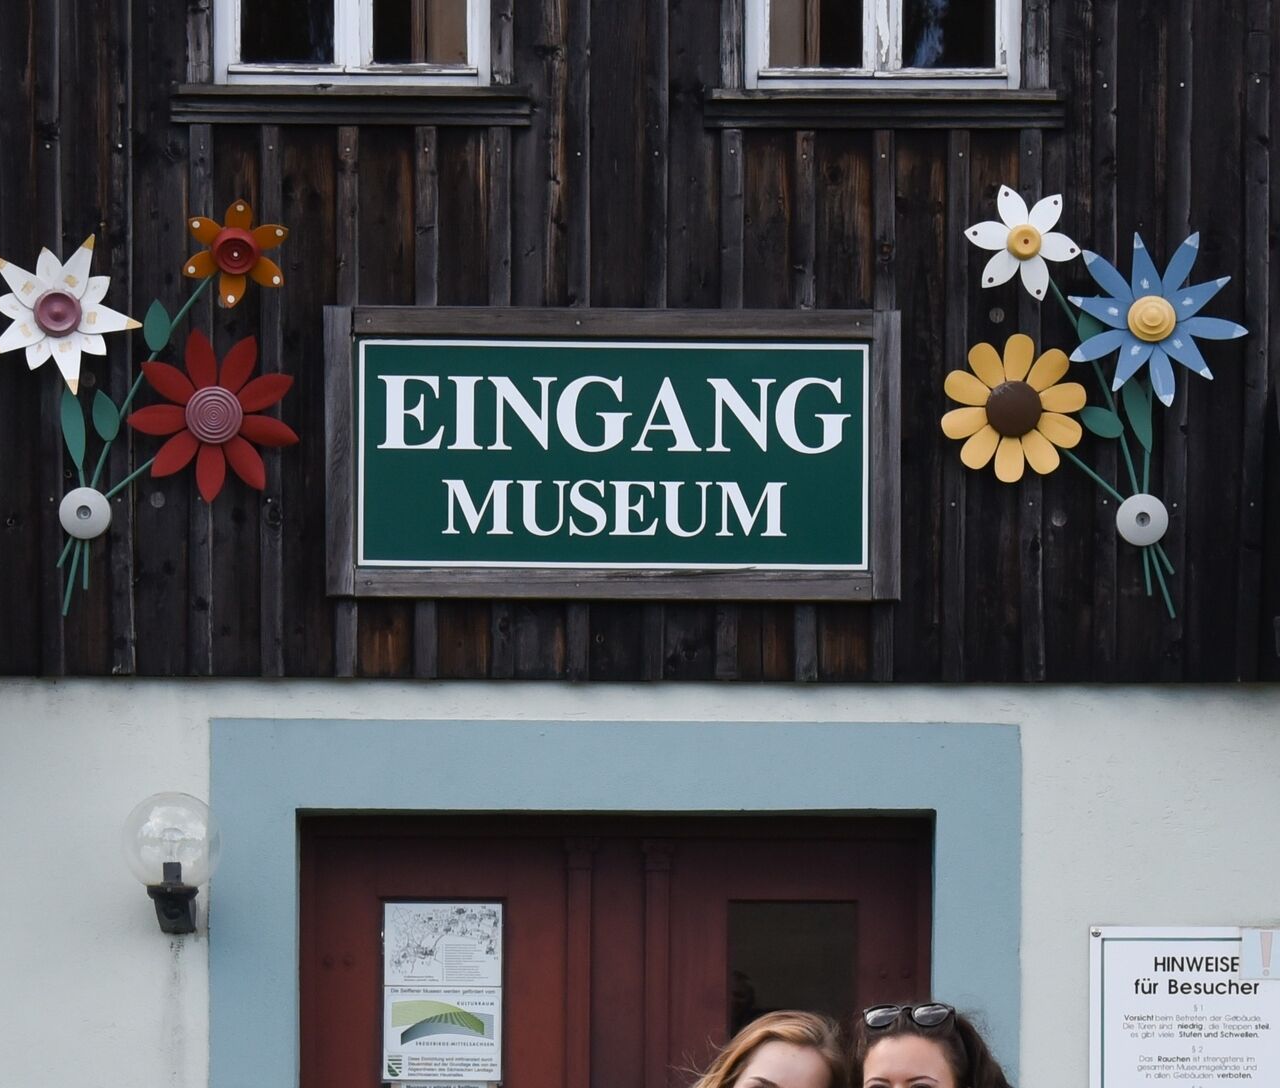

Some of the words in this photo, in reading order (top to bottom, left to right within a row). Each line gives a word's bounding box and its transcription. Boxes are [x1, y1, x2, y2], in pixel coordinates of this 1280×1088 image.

[376, 374, 851, 454] EINGANG
[441, 478, 787, 538] MUSEUM
[1153, 956, 1240, 972] HINWEISE
[1134, 978, 1159, 995] für
[1168, 979, 1260, 995] Besucher
[1222, 1023, 1252, 1031] Treppen
[1141, 1031, 1155, 1039] gibt
[1203, 1056, 1244, 1065] strengstens
[1137, 1064, 1174, 1072] gesamten
[1176, 1064, 1240, 1072] Museumsgelände
